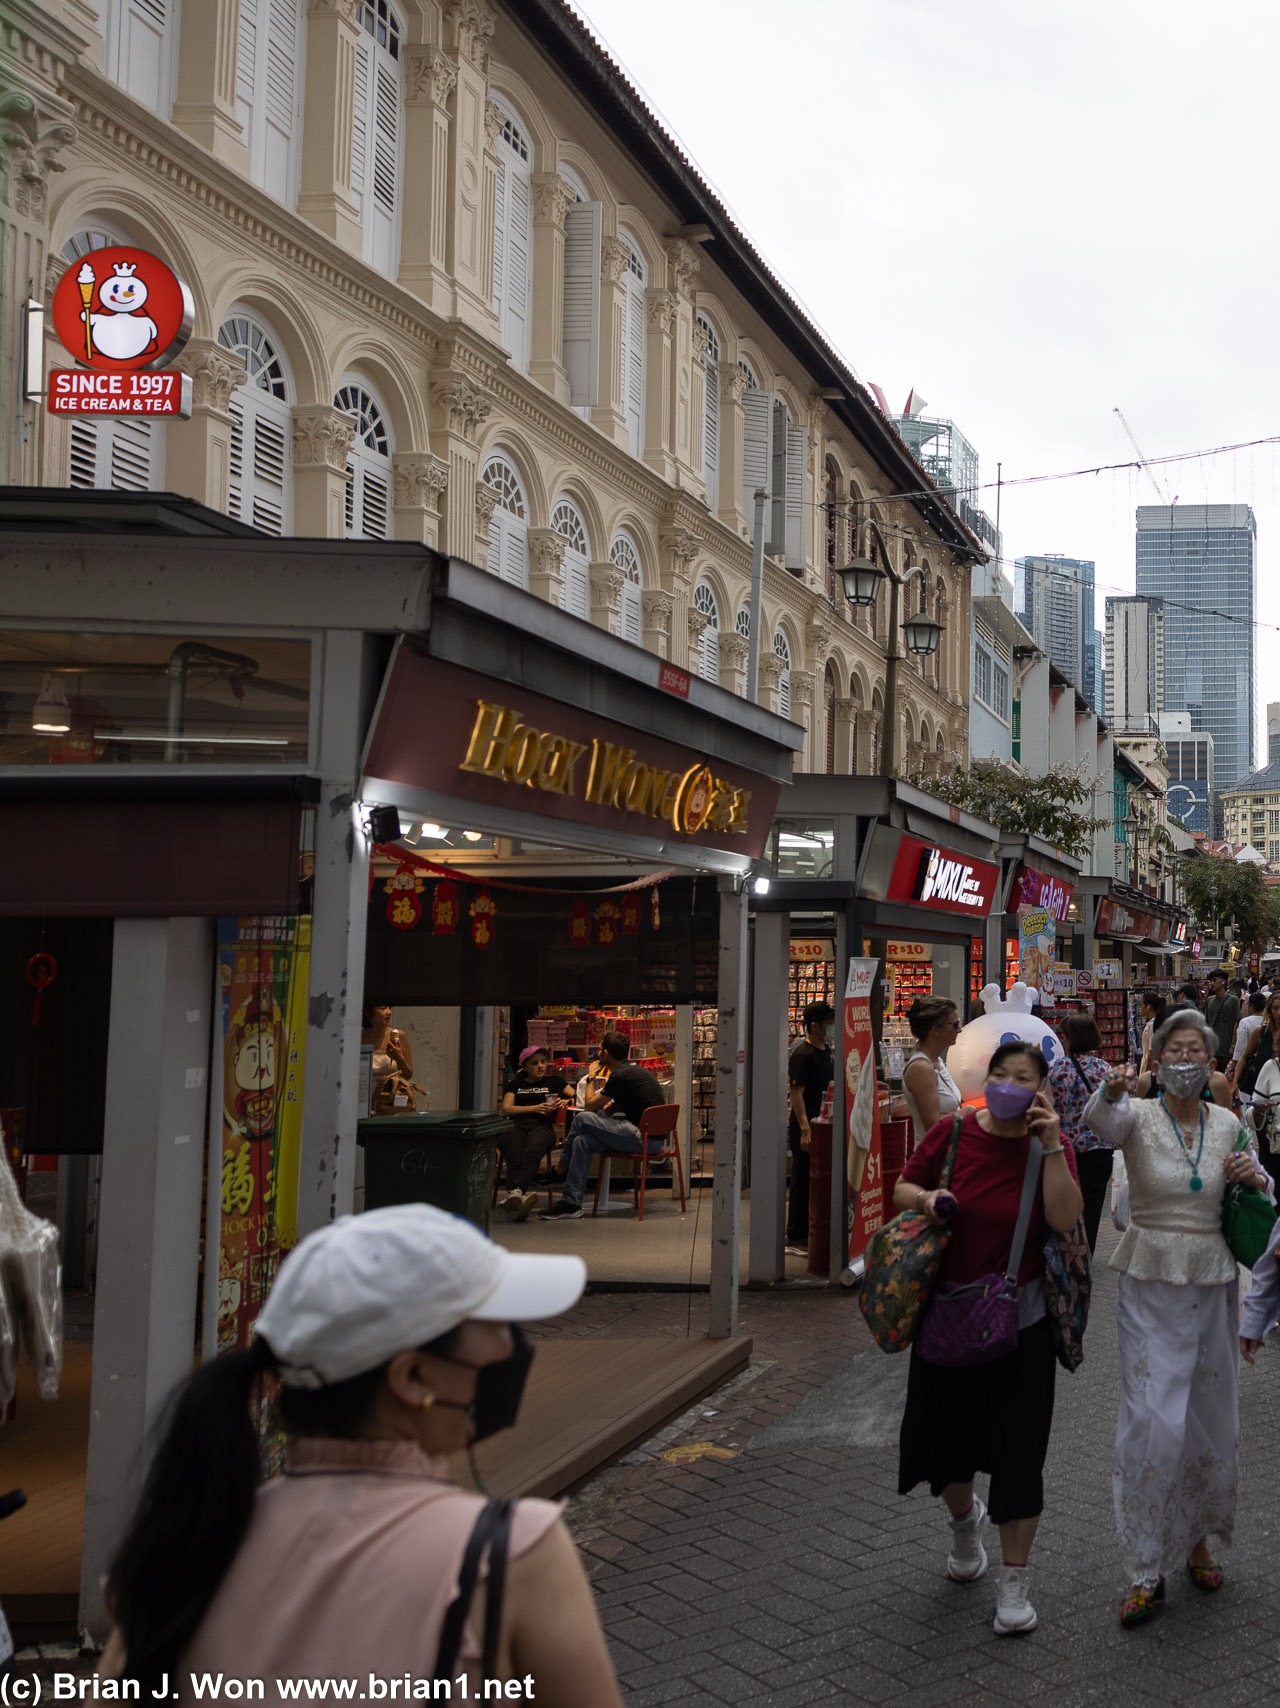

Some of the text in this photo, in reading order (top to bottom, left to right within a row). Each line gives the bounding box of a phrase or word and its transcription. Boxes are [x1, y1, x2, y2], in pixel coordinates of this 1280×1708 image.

[56, 374, 173, 395] SINCE 1997
[55, 397, 172, 412] ICE CREAM & TEA
[458, 699, 586, 797] HOCK
[868, 1153, 881, 1184] $1
